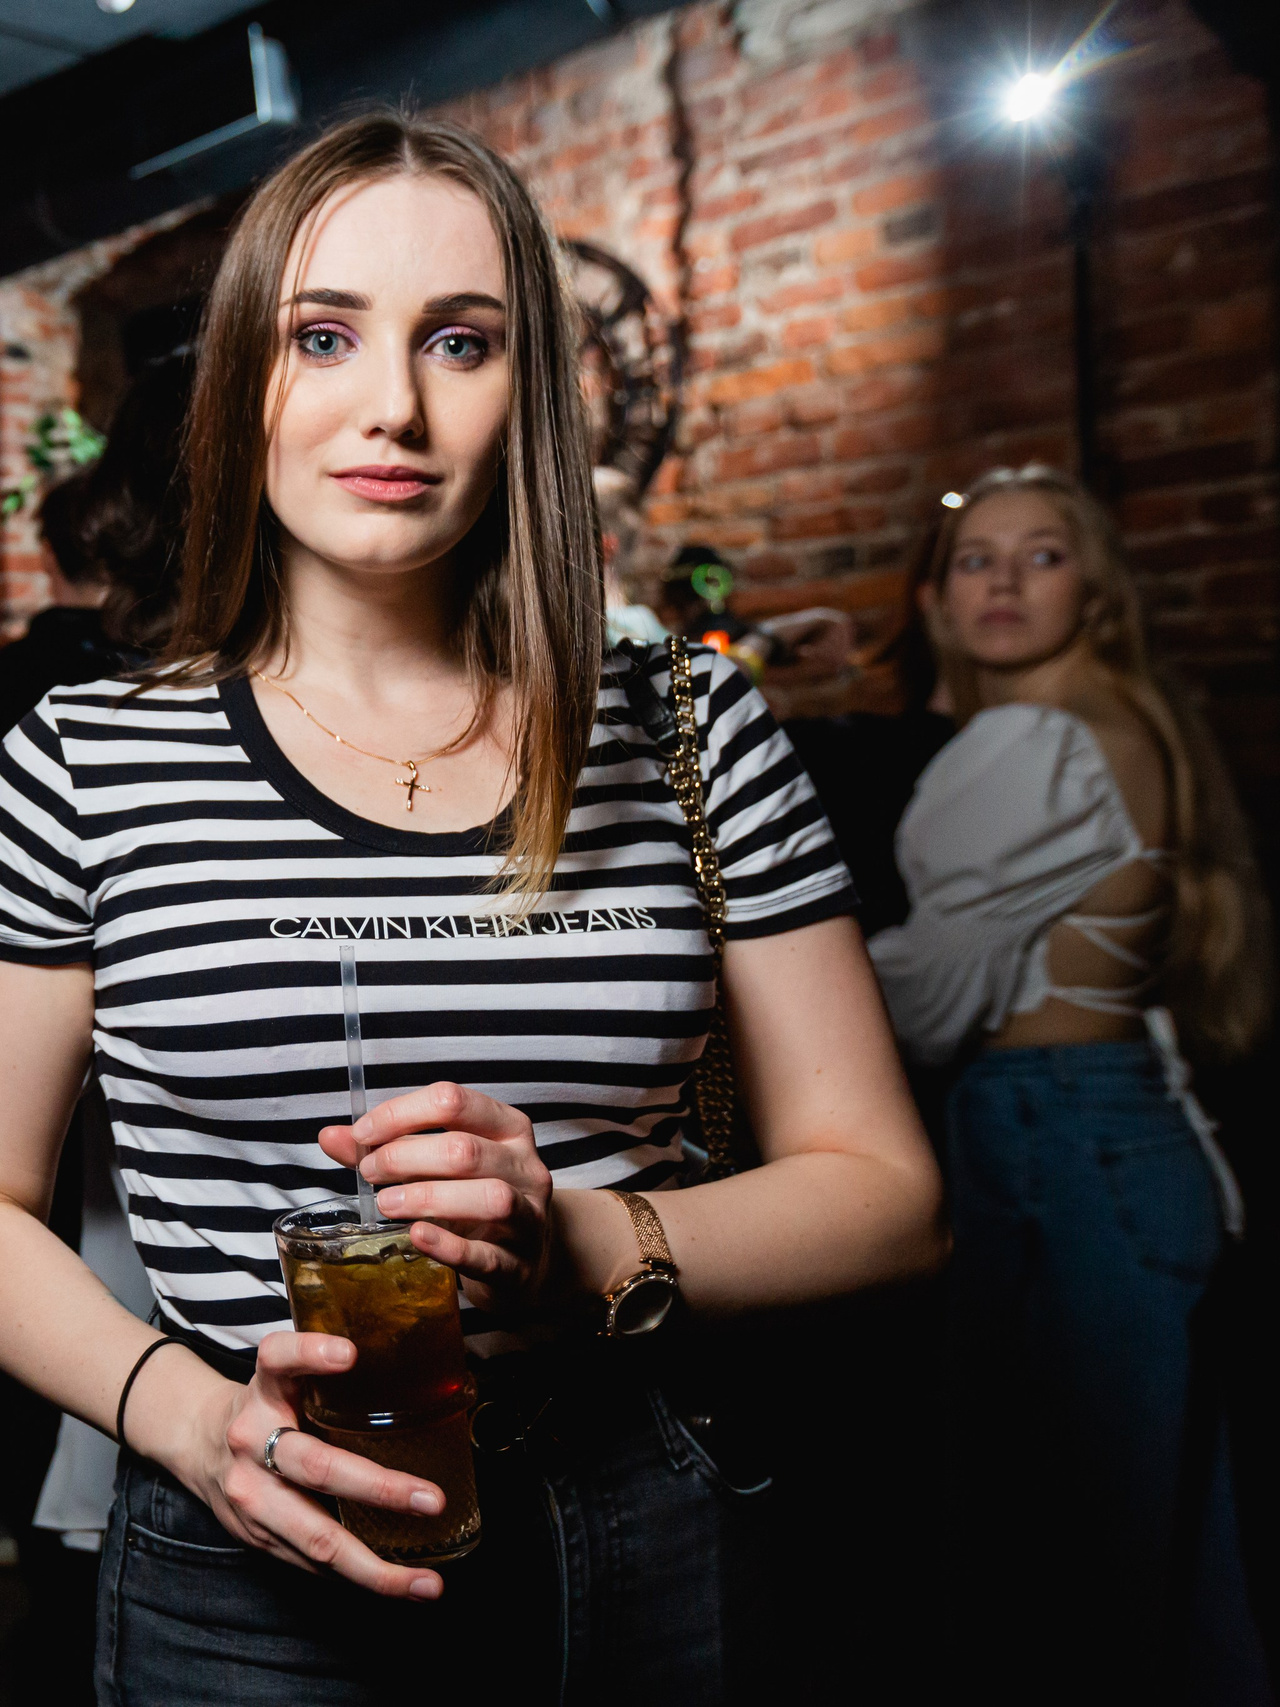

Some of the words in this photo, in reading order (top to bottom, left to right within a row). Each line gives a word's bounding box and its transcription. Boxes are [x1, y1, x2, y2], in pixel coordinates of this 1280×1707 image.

[270, 916, 411, 940] CALVIN
[423, 914, 533, 939] KLEIN
[542, 907, 657, 934] JEANS
